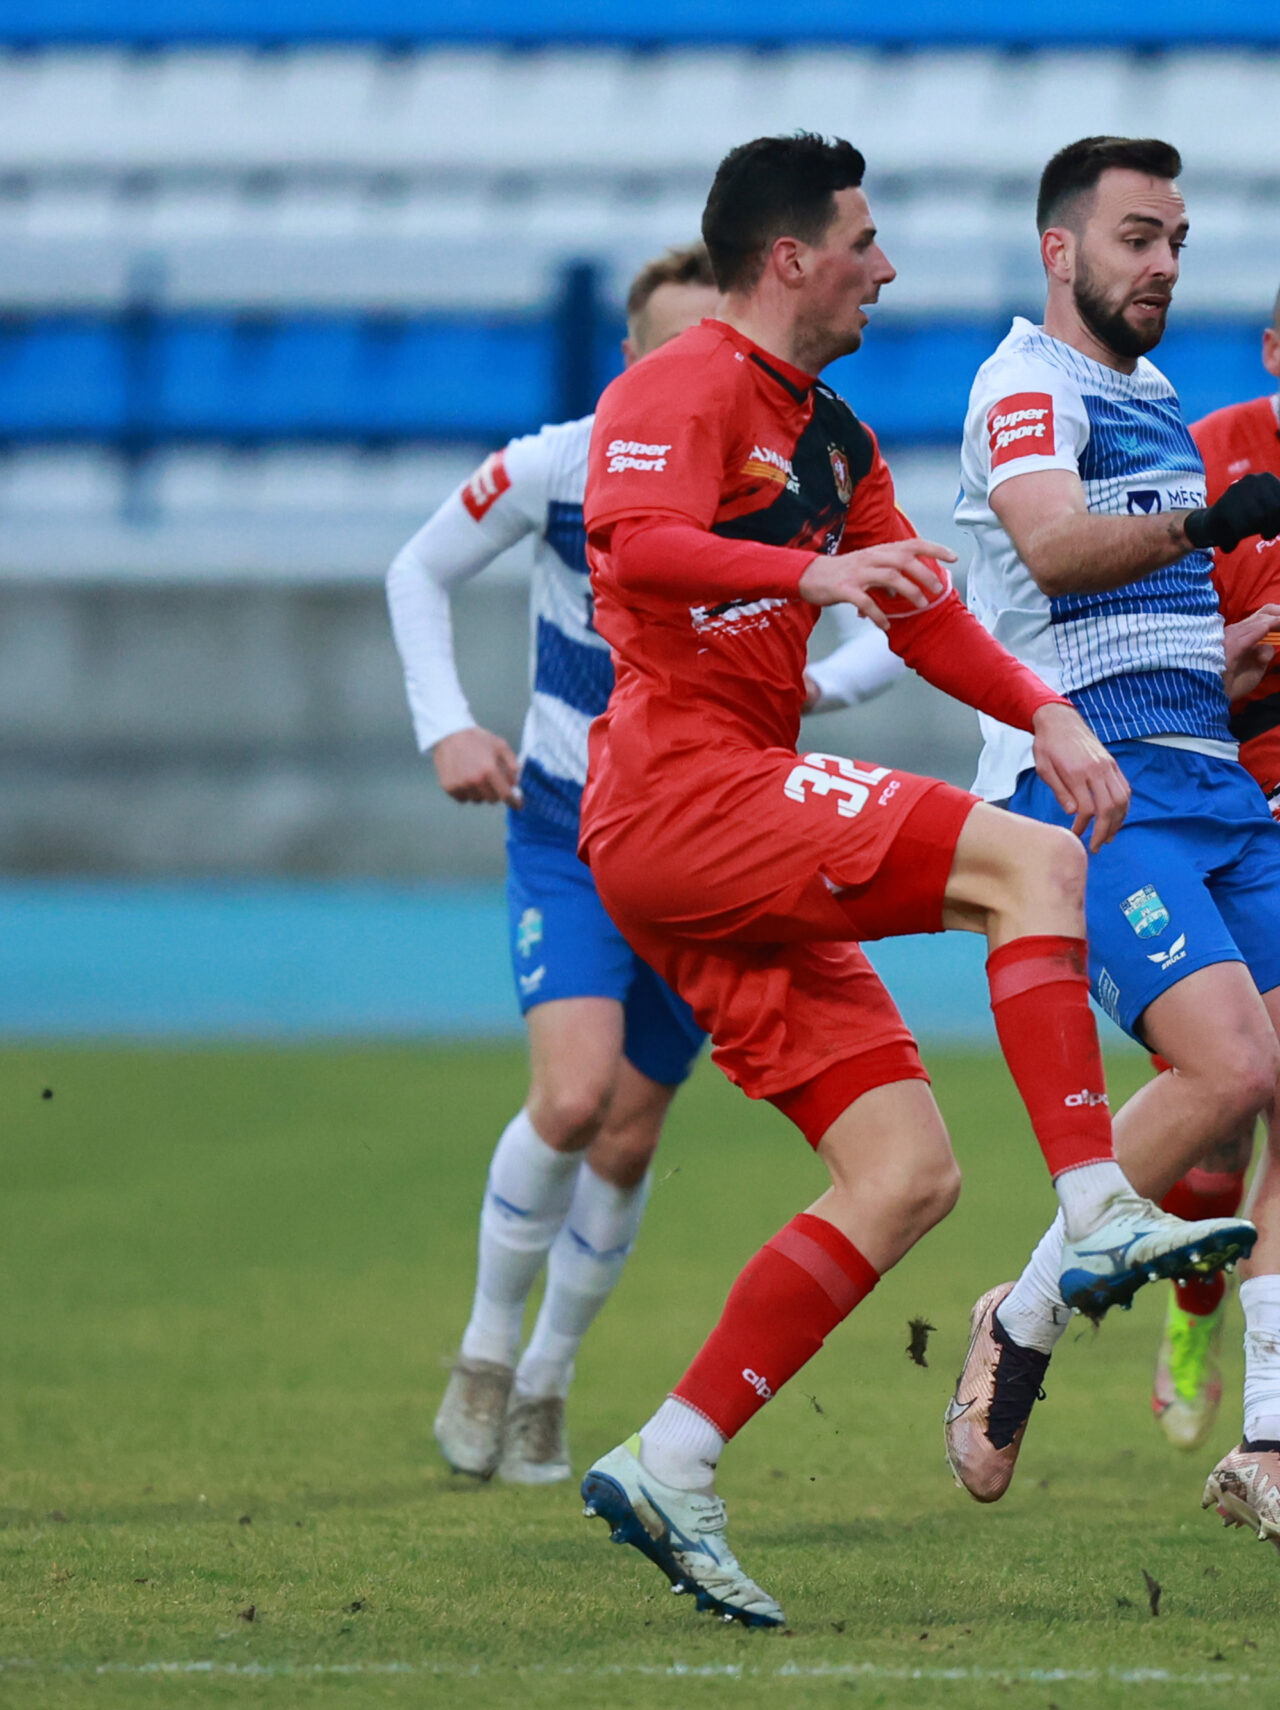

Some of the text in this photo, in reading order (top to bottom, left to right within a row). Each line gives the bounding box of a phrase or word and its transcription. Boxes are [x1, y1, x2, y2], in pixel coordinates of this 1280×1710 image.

[991, 408, 1049, 436] Super
[994, 422, 1047, 450] Sport
[605, 439, 672, 457] Super
[606, 455, 667, 473] Sport
[784, 752, 893, 819] 32
[742, 1368, 774, 1399] alp
